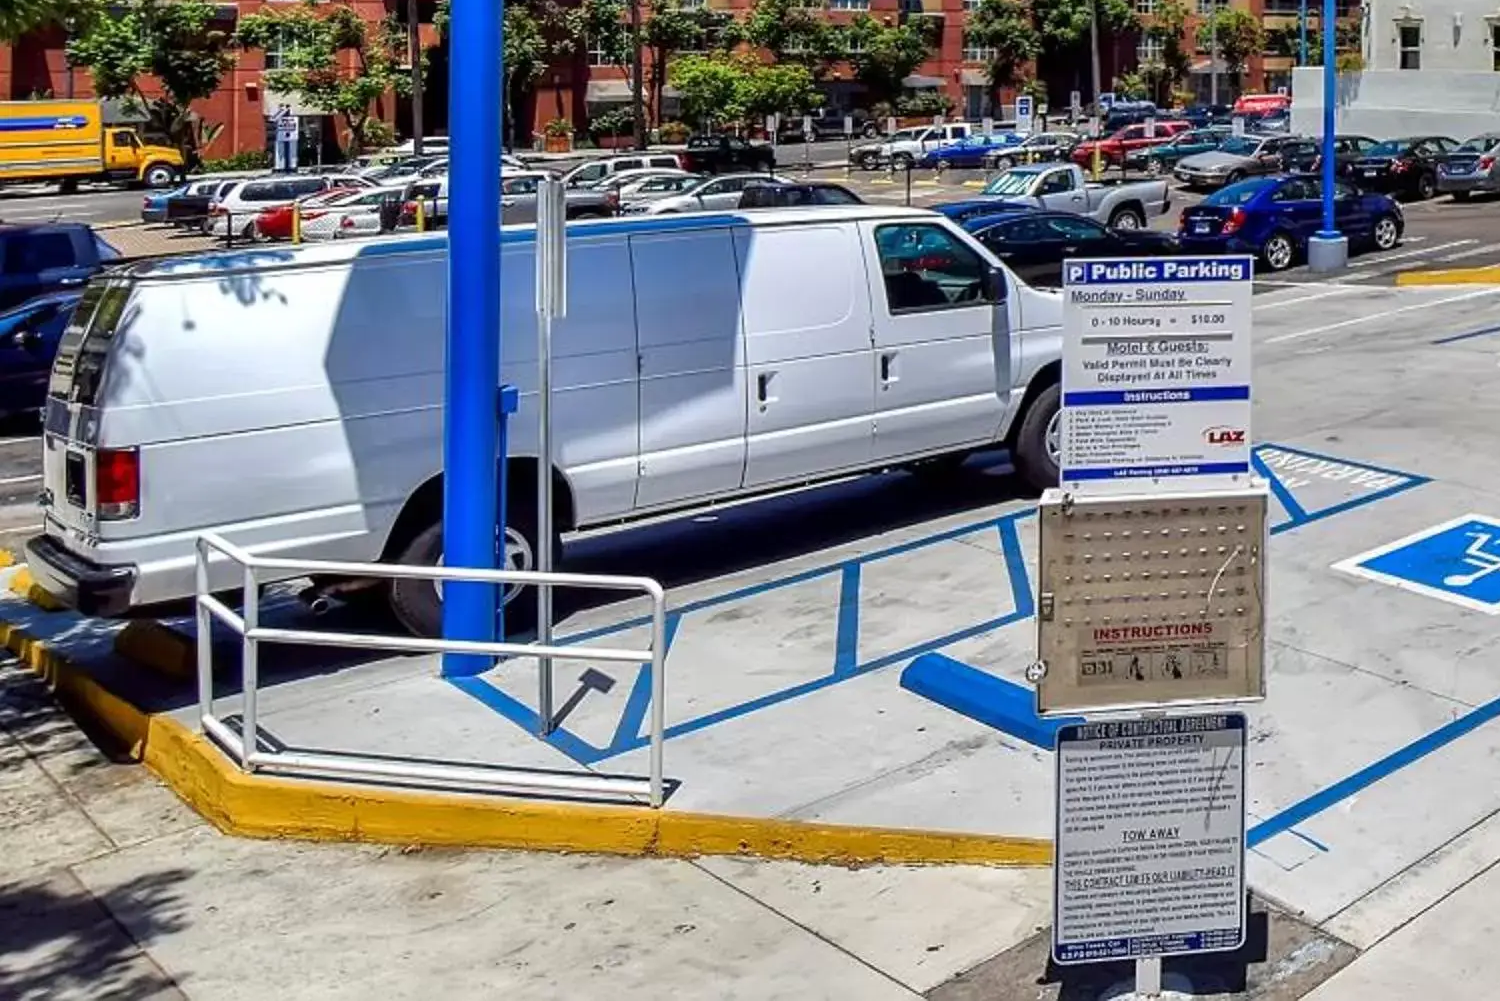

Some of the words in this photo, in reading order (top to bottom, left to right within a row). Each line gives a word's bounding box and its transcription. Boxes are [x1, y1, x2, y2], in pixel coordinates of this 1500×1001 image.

[1091, 263, 1157, 280] Public
[1163, 261, 1243, 280] Parking
[1071, 289, 1123, 303] Monday
[1135, 288, 1185, 302] Sunday
[1091, 318, 1099, 328] 0
[1107, 342, 1143, 355] Motel
[1082, 360, 1109, 370] Valid
[1112, 359, 1147, 369] Permit
[1150, 358, 1176, 368] Must
[1178, 357, 1193, 367] Be
[1195, 356, 1232, 368] Clearly
[1097, 372, 1150, 384] Displayed
[1168, 370, 1183, 380] All
[1186, 369, 1217, 380] Times
[1124, 390, 1191, 402] Instructions
[1209, 430, 1245, 444] LAZ
[1093, 622, 1213, 640] INSTRUCTIONS
[1100, 738, 1143, 750] PRIVATE
[1148, 734, 1205, 747] PROPERTY
[1122, 830, 1147, 843] TOW
[1150, 827, 1180, 840] AWAY
